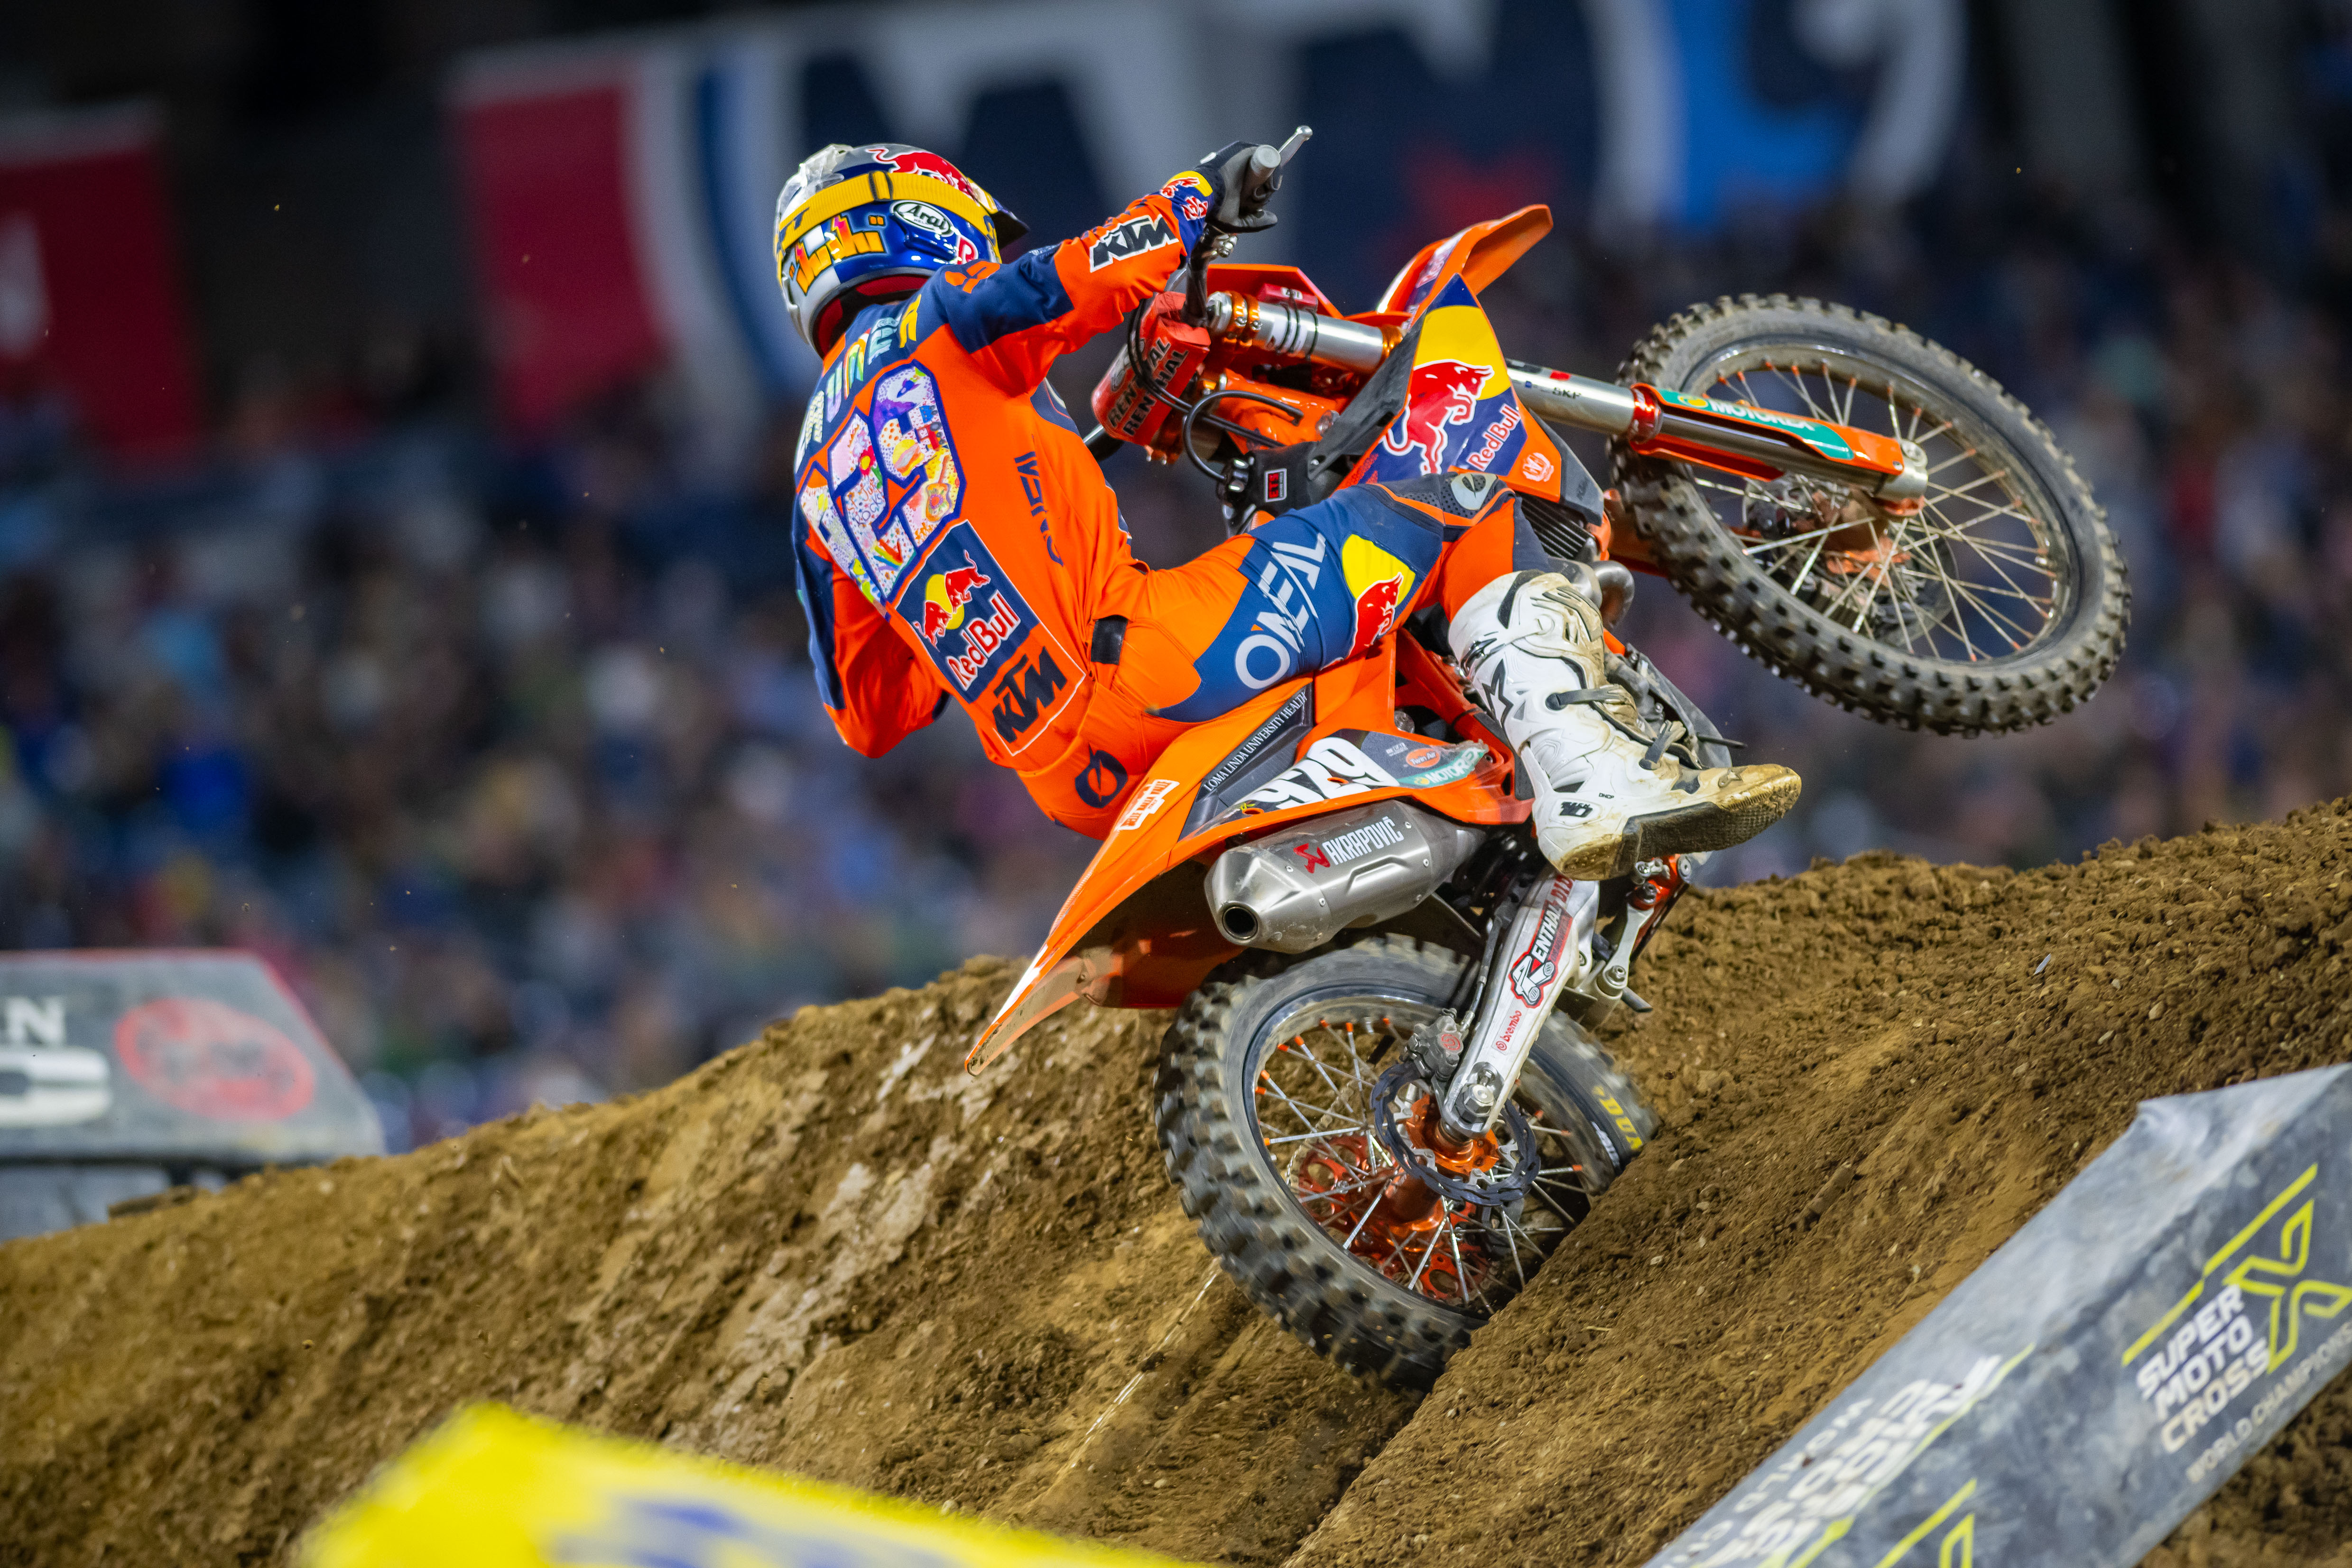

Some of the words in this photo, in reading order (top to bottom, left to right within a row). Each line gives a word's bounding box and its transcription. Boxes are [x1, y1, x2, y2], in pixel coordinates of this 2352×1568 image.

[906, 204, 949, 230] Arai
[1089, 213, 1179, 273] KTM
[1107, 337, 1172, 428] RENAL
[1122, 350, 1189, 436] RENHAL
[1552, 387, 1582, 399] SKF
[1268, 472, 1279, 499] ETS
[1235, 533, 1326, 689] O'NEAL
[992, 646, 1067, 743] KTM
[1204, 770, 1229, 792] LOMA
[1223, 751, 1249, 774] LINDA
[1243, 714, 1285, 754] UNIVERSITY
[1281, 691, 1308, 719] HEALTH
[1234, 736, 1400, 810] 929
[1409, 755, 1428, 765] Twin
[1425, 747, 1486, 784] MOTOREX
[1559, 805, 1593, 818] 10
[1510, 900, 1563, 1006] RENTHAL
[1500, 1010, 1523, 1043] brembo
[2137, 1283, 2244, 1401] SUPER
[2156, 1315, 2253, 1421] MOTO
[2161, 1337, 2270, 1454] CROSS
[2186, 1418, 2253, 1484] WORLD
